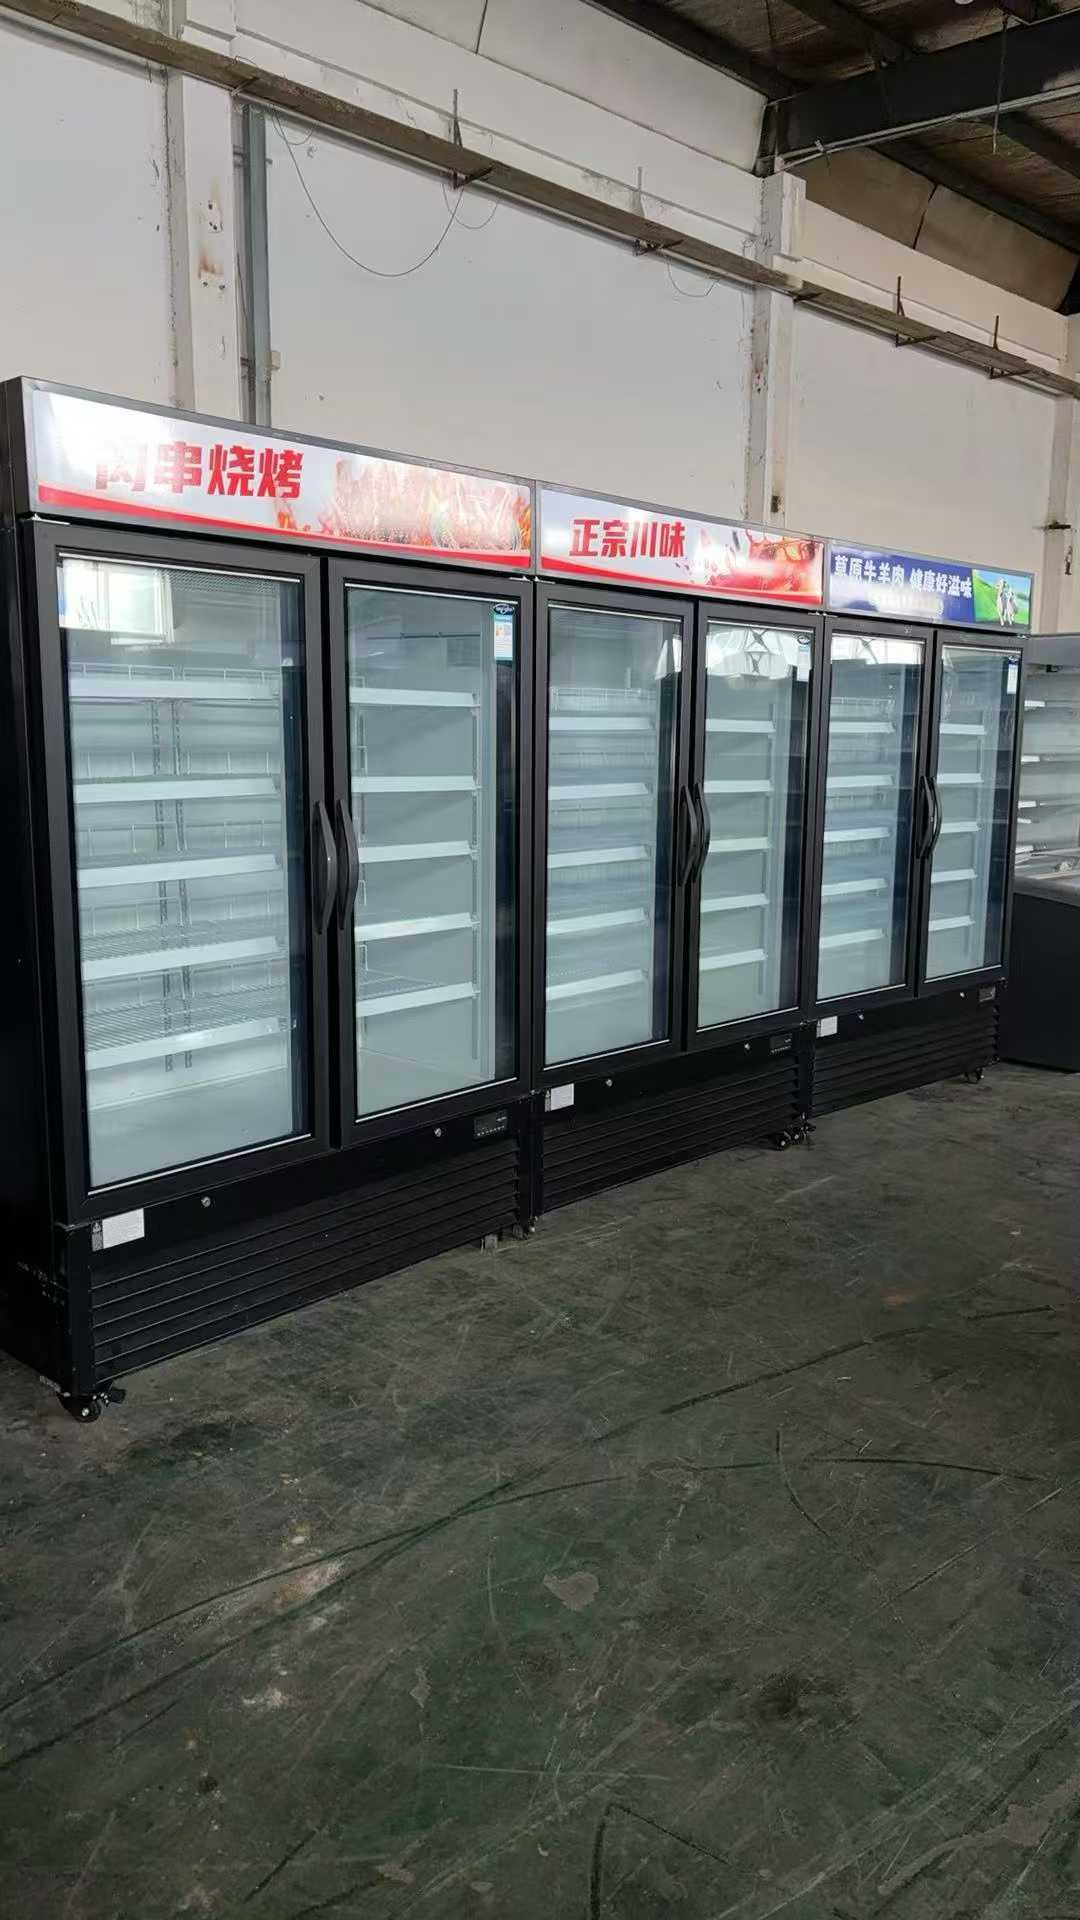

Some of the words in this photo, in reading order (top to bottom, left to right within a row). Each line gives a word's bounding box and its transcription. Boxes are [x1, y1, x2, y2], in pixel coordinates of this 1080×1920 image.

[569, 519, 686, 558] 正宗川味
[834, 555, 905, 588] 草原牛羊肉
[909, 567, 973, 599] 健康好滋味
